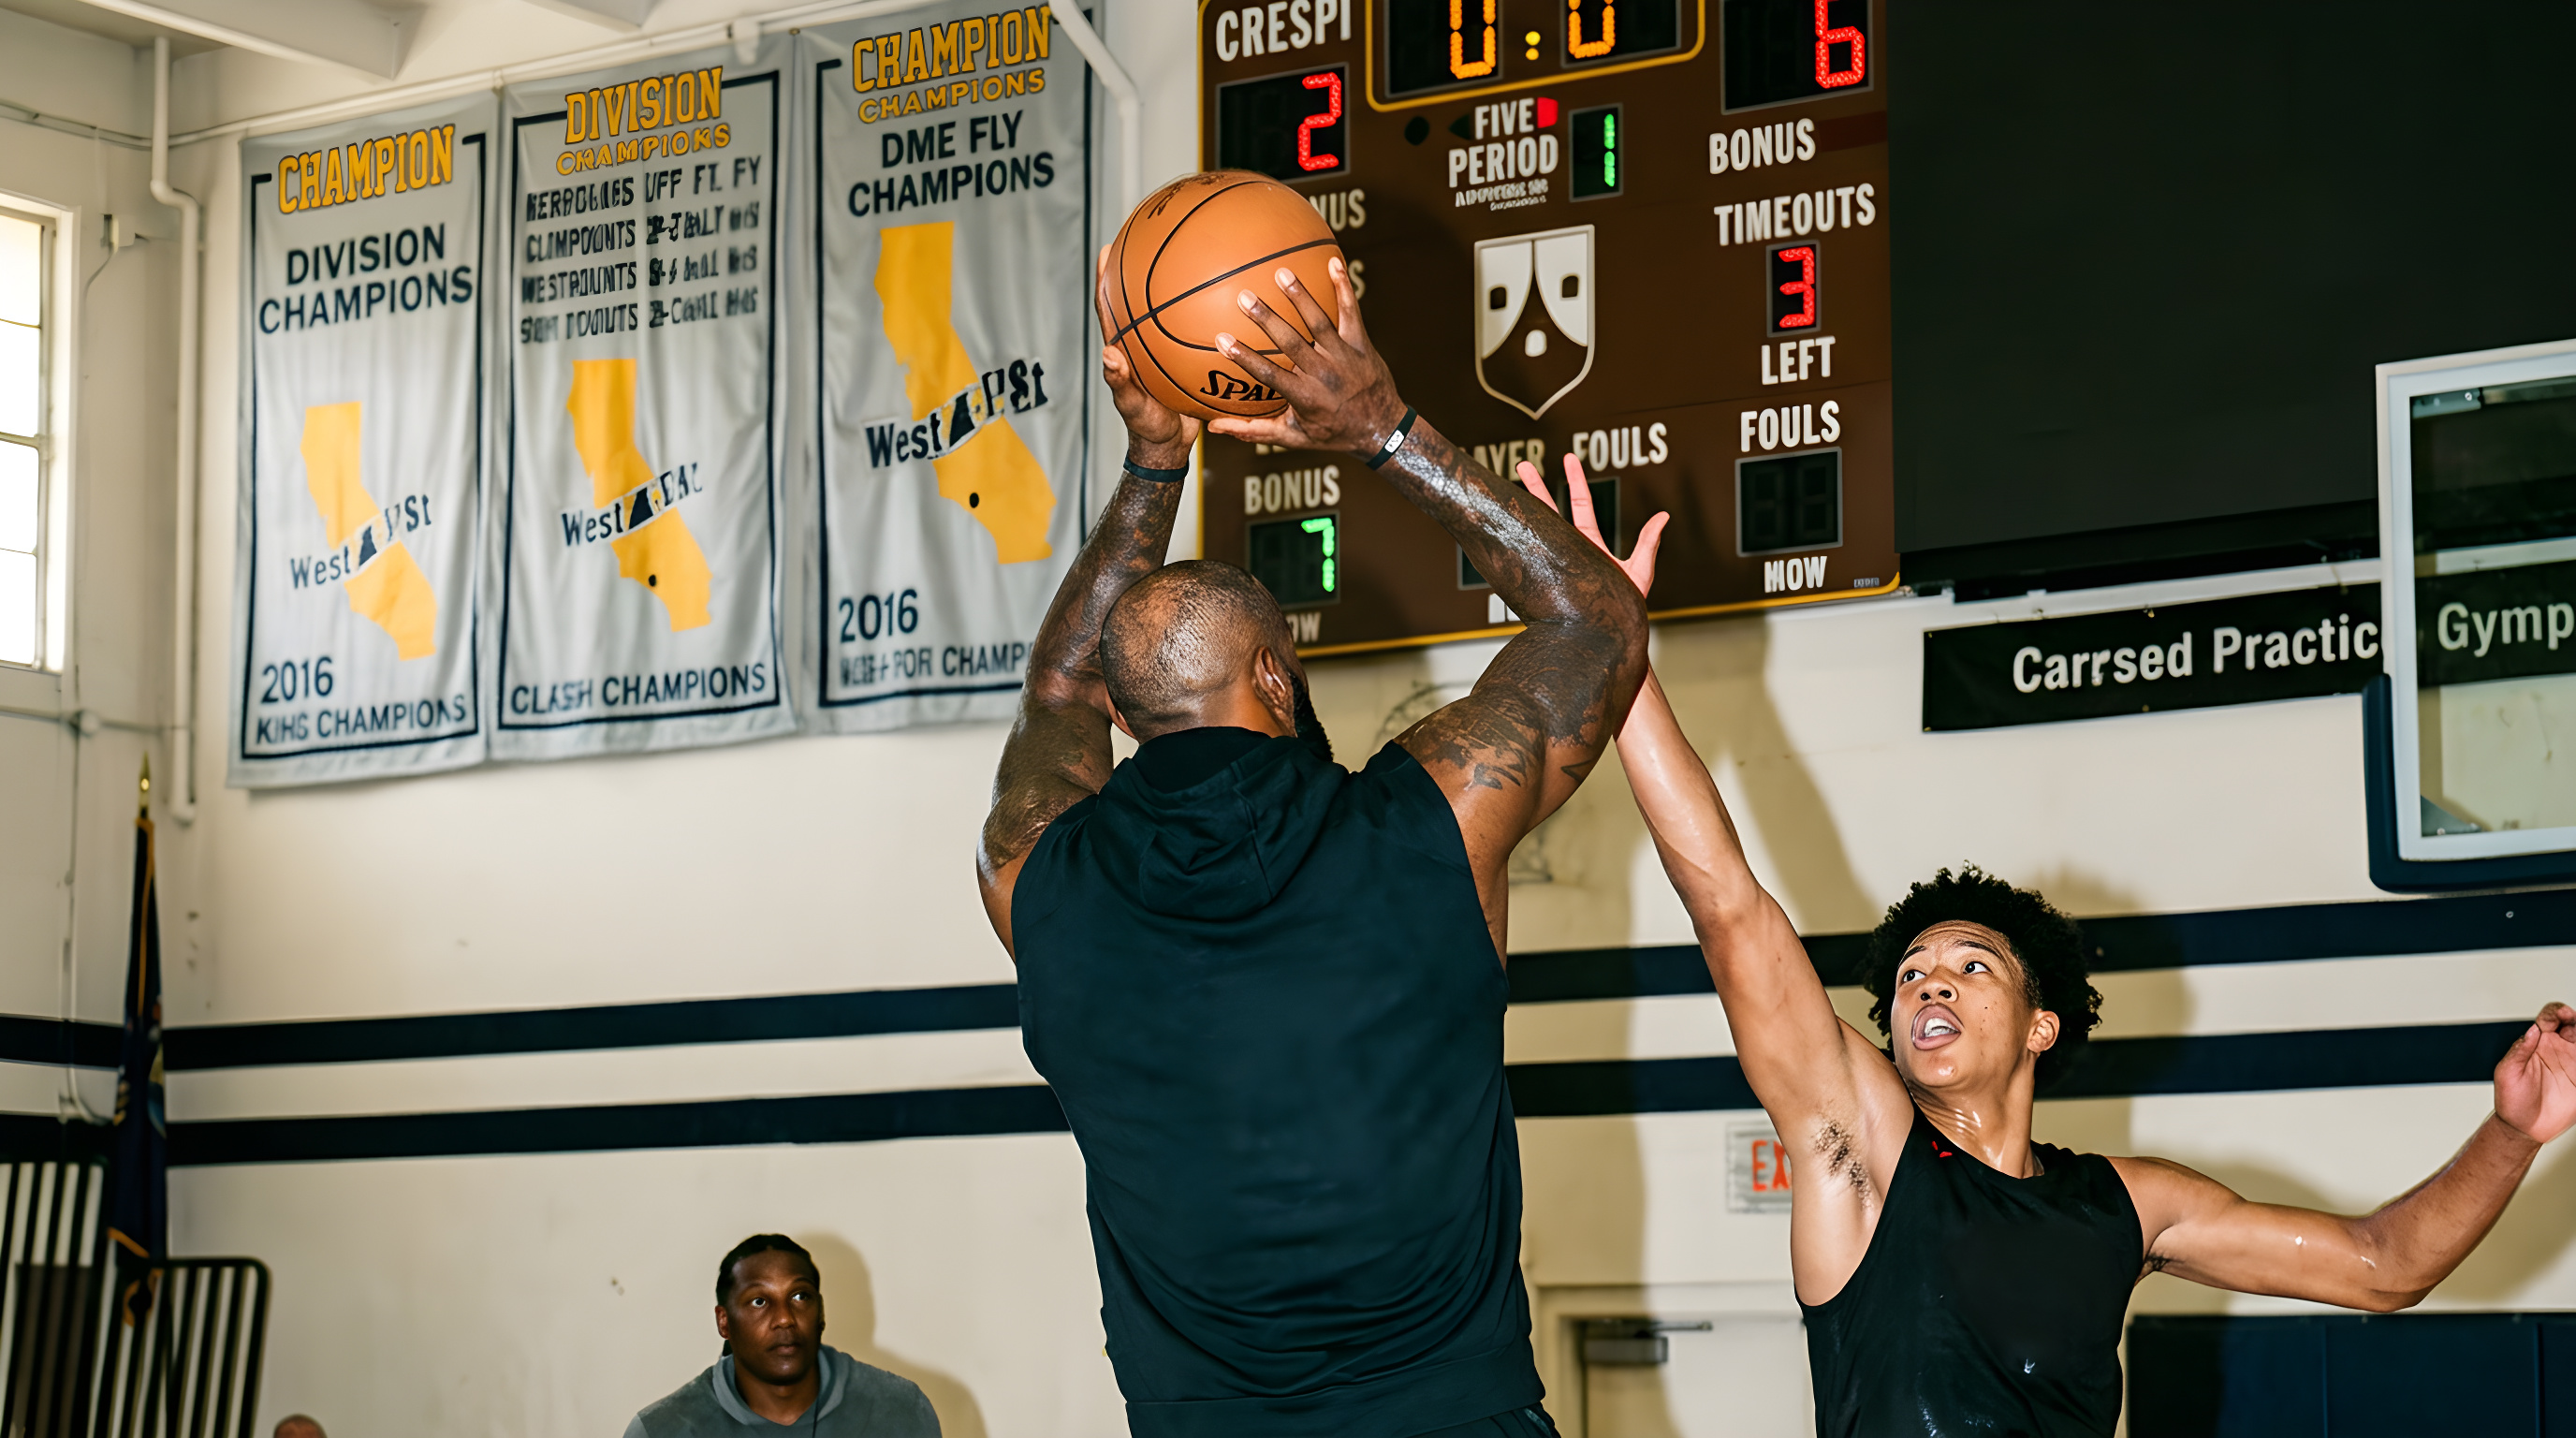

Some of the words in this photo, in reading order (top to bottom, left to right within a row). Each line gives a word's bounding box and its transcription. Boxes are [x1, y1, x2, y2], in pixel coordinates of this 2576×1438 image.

[853, 3, 1052, 94] CHAMPION
[1216, 0, 1351, 62] CRESPI
[1814, 0, 1866, 89] 6
[564, 66, 724, 145] DIVISION
[858, 67, 1046, 124] CHAMPIONS
[1297, 72, 1342, 171] 2
[1475, 97, 1534, 140] FIVE
[882, 121, 956, 169] DME
[970, 110, 1023, 154] FLY
[1448, 134, 1559, 188] PERIOD
[1603, 112, 1617, 187] 1
[1708, 118, 1816, 175] BONUS
[278, 123, 456, 214] CHAMPION
[849, 152, 1055, 217] CHAMPIONS
[1309, 188, 1367, 232] NUS
[1714, 183, 1876, 246] TIMEOUTS
[286, 223, 445, 286] DIVISION
[259, 266, 474, 334] CHAMPIONS
[1778, 246, 1816, 329] 3
[1199, 370, 1285, 401] SPAL
[1761, 335, 1836, 386] LEFT
[866, 412, 943, 469] West
[1473, 438, 1544, 482] AYER
[1573, 422, 1669, 472] FOULS
[1740, 400, 1841, 453] FOULS
[1244, 464, 1340, 515] BONUS
[561, 503, 623, 548] West
[290, 545, 351, 589] West
[1301, 517, 1336, 593] 7
[839, 588, 919, 644] 2016
[2213, 613, 2379, 674] Practic
[2437, 601, 2576, 658] Gymp
[260, 656, 334, 704] 2016
[602, 663, 766, 706] CHAMPIONS
[316, 694, 467, 739] CHAMPIONS
[1751, 1139, 1790, 1192] EX
